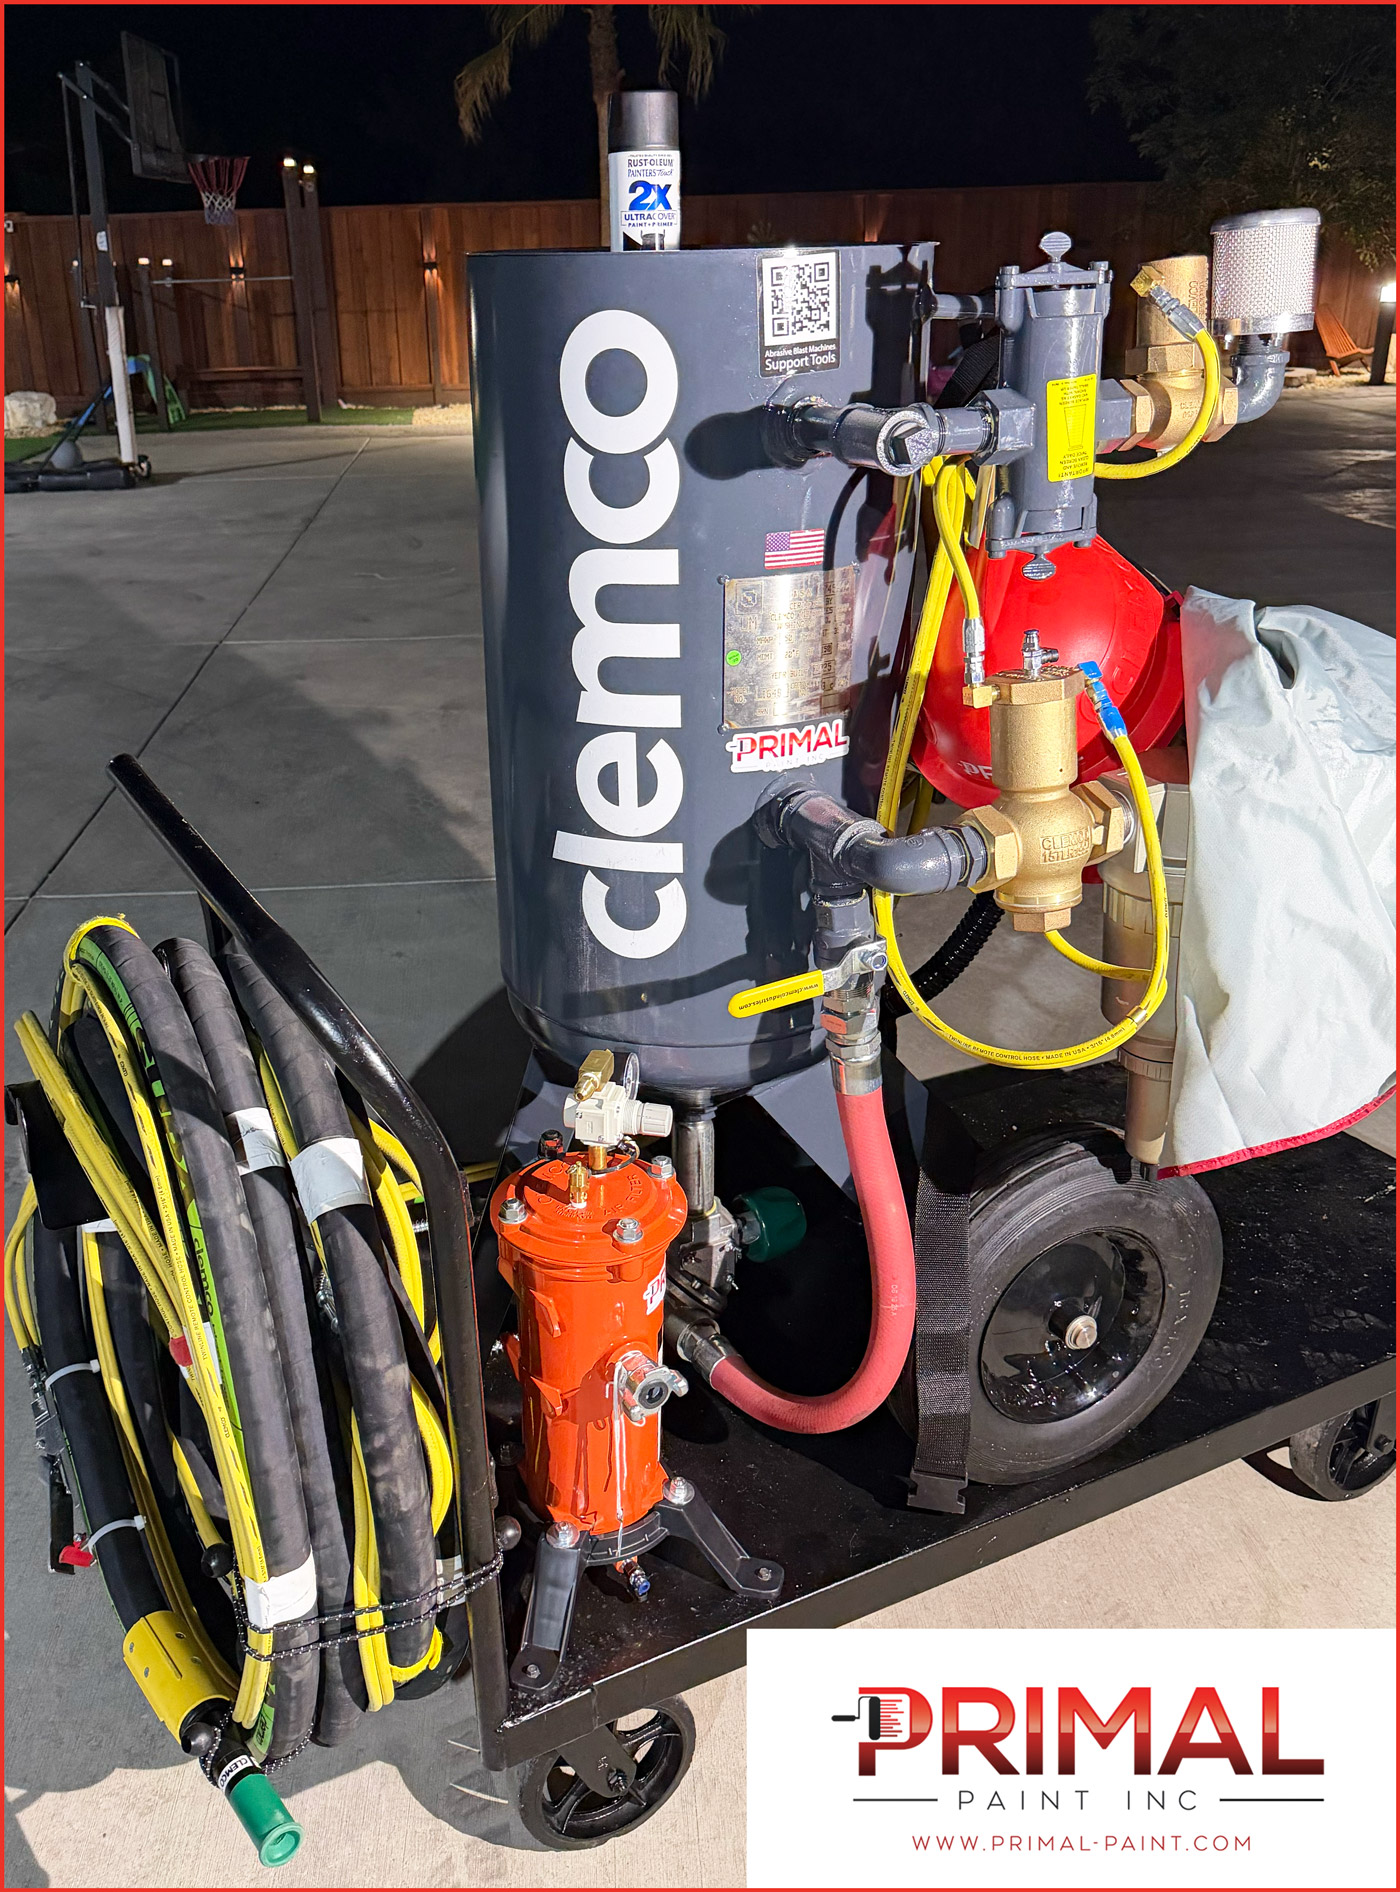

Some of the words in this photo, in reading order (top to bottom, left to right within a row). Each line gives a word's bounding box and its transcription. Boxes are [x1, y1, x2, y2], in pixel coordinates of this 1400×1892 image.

[627, 169, 656, 178] PAINTERS
[628, 180, 672, 211] 2X
[765, 348, 793, 358] Abrasive
[793, 346, 808, 355] Blast
[808, 343, 836, 353] Machines
[765, 355, 809, 371] Support
[811, 352, 836, 366] Tools
[552, 309, 687, 960] clemco
[737, 722, 848, 762] PRIMAL
[1042, 830, 1090, 851] CLEMCO
[738, 983, 819, 1011] www.clemcoindustries.com
[949, 1034, 972, 1049] TWINLINE
[972, 1045, 995, 1058] REMOTE
[995, 1052, 1022, 1061] CONTROL
[1045, 1052, 1063, 1060] MADE
[1072, 1047, 1086, 1057] USA
[178, 1273, 193, 1304] CONTROL
[187, 1303, 200, 1331] REMOTE
[220, 1757, 248, 1788] CLEMCO
